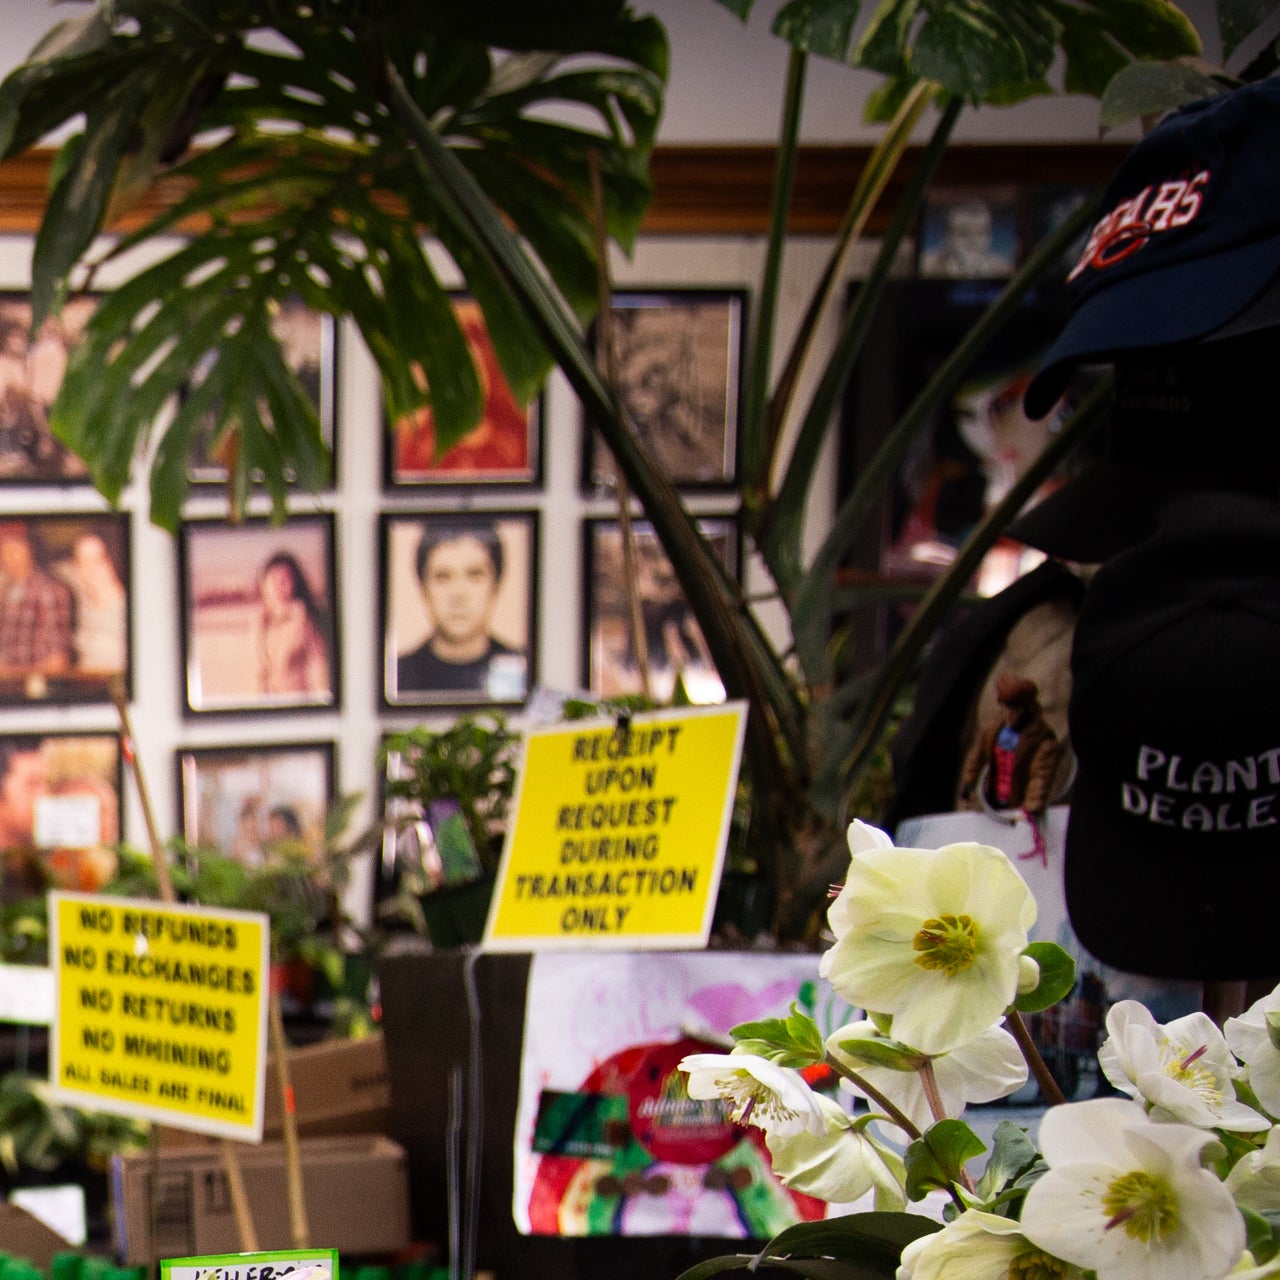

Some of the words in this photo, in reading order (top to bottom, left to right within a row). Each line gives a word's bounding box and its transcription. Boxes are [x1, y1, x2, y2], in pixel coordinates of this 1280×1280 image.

[584, 765, 658, 796] UPON
[1136, 744, 1280, 794] PLANT
[556, 797, 678, 832] REQUEST
[1120, 780, 1280, 832] DEALE
[560, 834, 660, 865] DURING
[516, 868, 698, 899] TRANSACTION
[79, 908, 114, 934] NO
[123, 911, 238, 951] REFUNDS
[561, 904, 632, 934] ONLY
[64, 946, 98, 971] NO
[105, 951, 256, 996] EXCHANGES
[79, 987, 114, 1013] NO
[122, 992, 237, 1035] RETURNS
[82, 1027, 116, 1053] NO
[124, 1033, 232, 1076] WHINING
